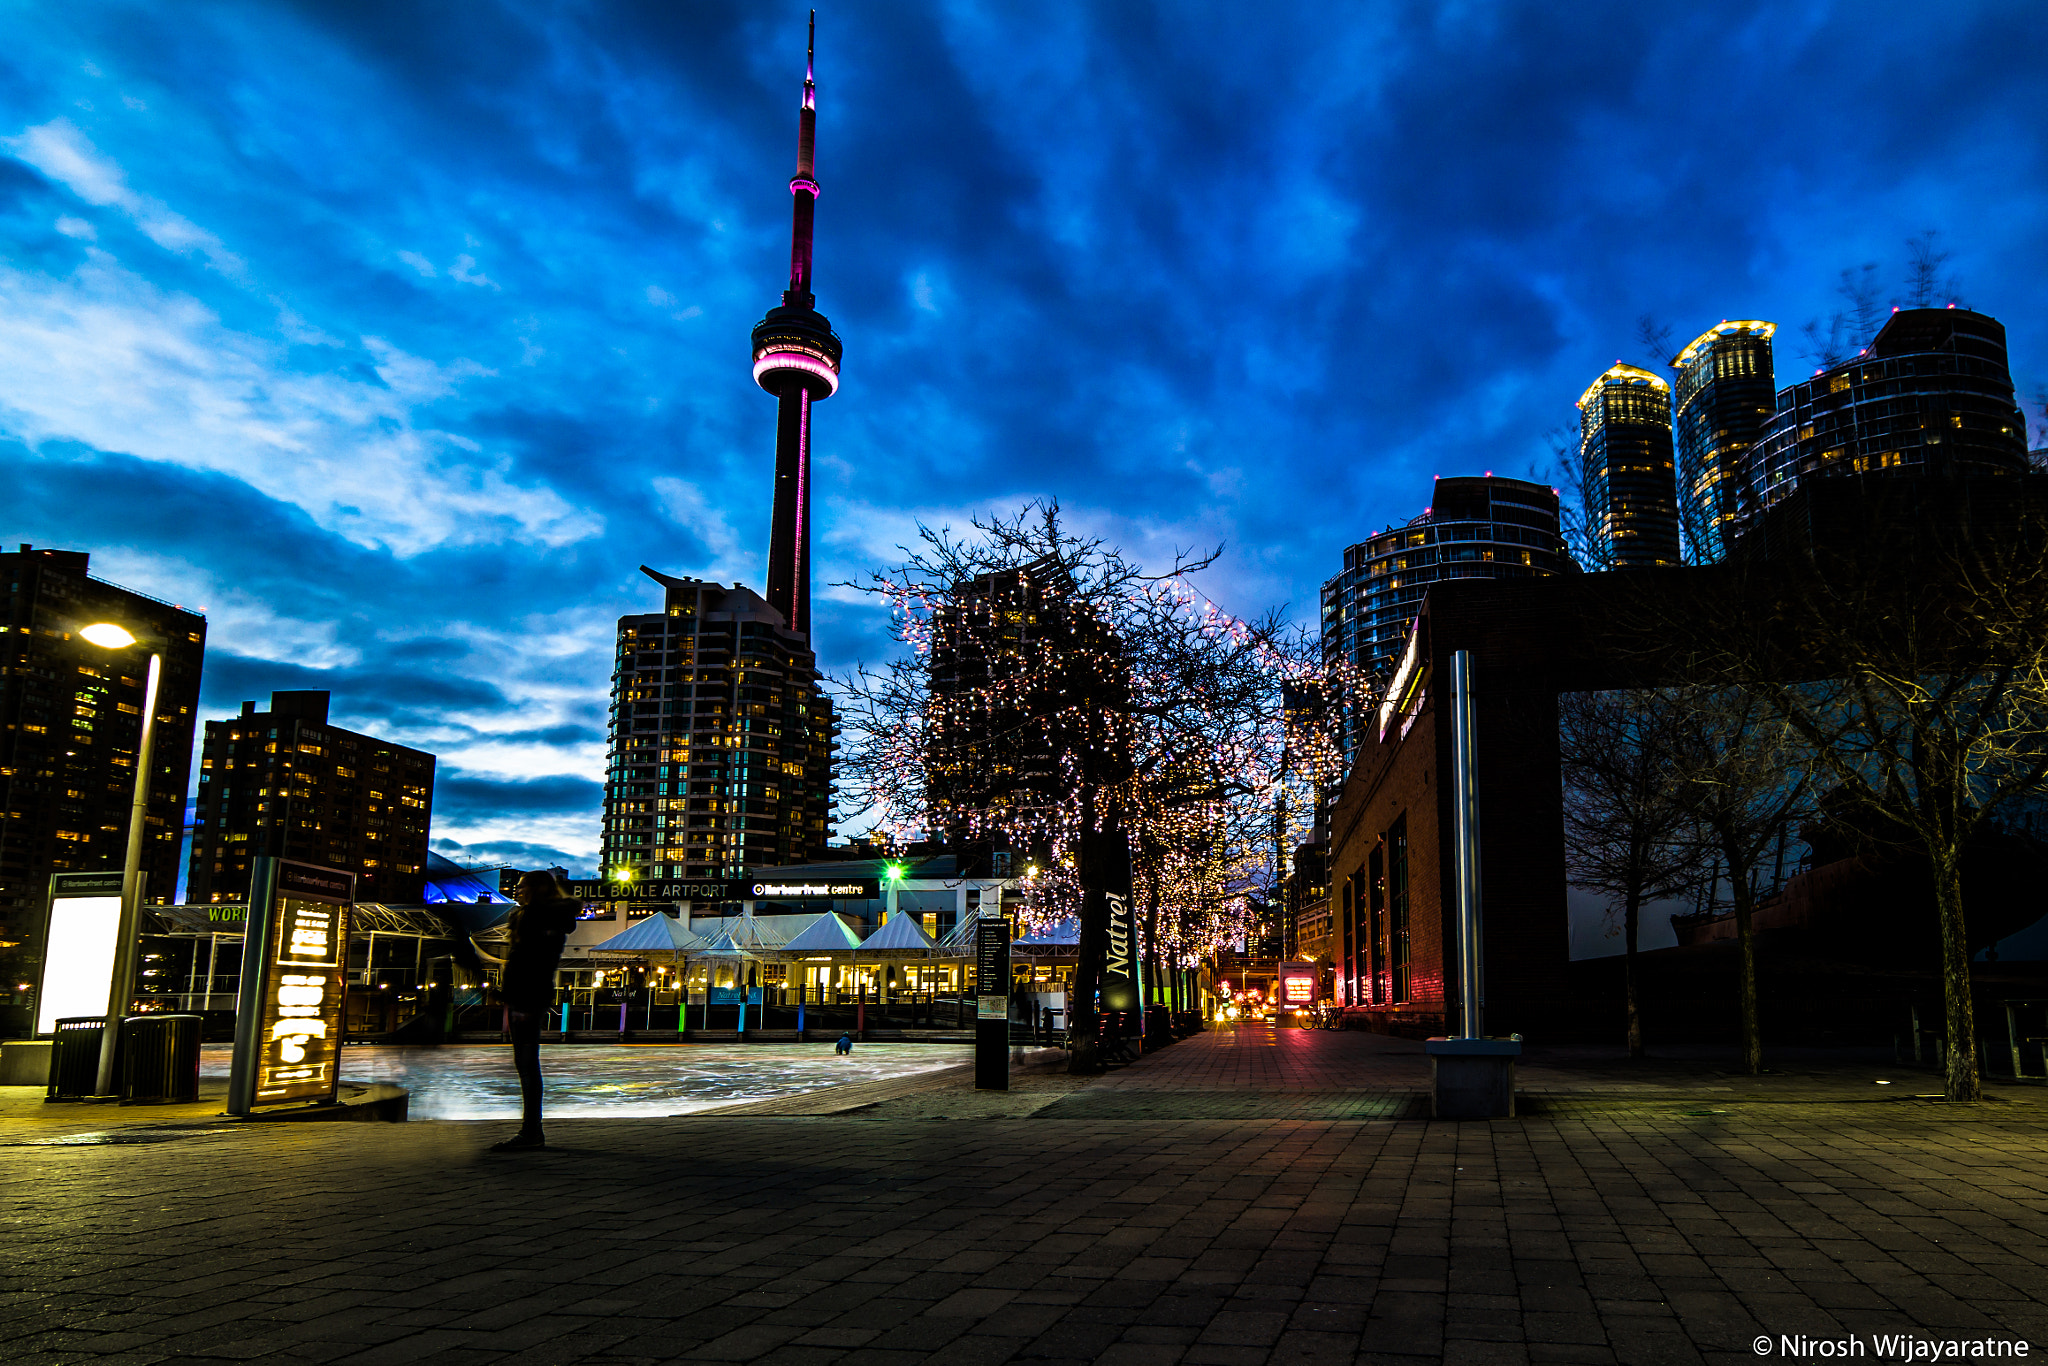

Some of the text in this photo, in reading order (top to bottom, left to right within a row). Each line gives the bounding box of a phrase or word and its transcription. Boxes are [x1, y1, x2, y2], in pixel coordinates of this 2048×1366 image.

[573, 884, 728, 897] BILL BOYLE ARTPORT
[764, 884, 864, 896] Harbourfront centre
[1106, 892, 1130, 978] Natrel
[1046, 982, 1064, 992] PATIO
